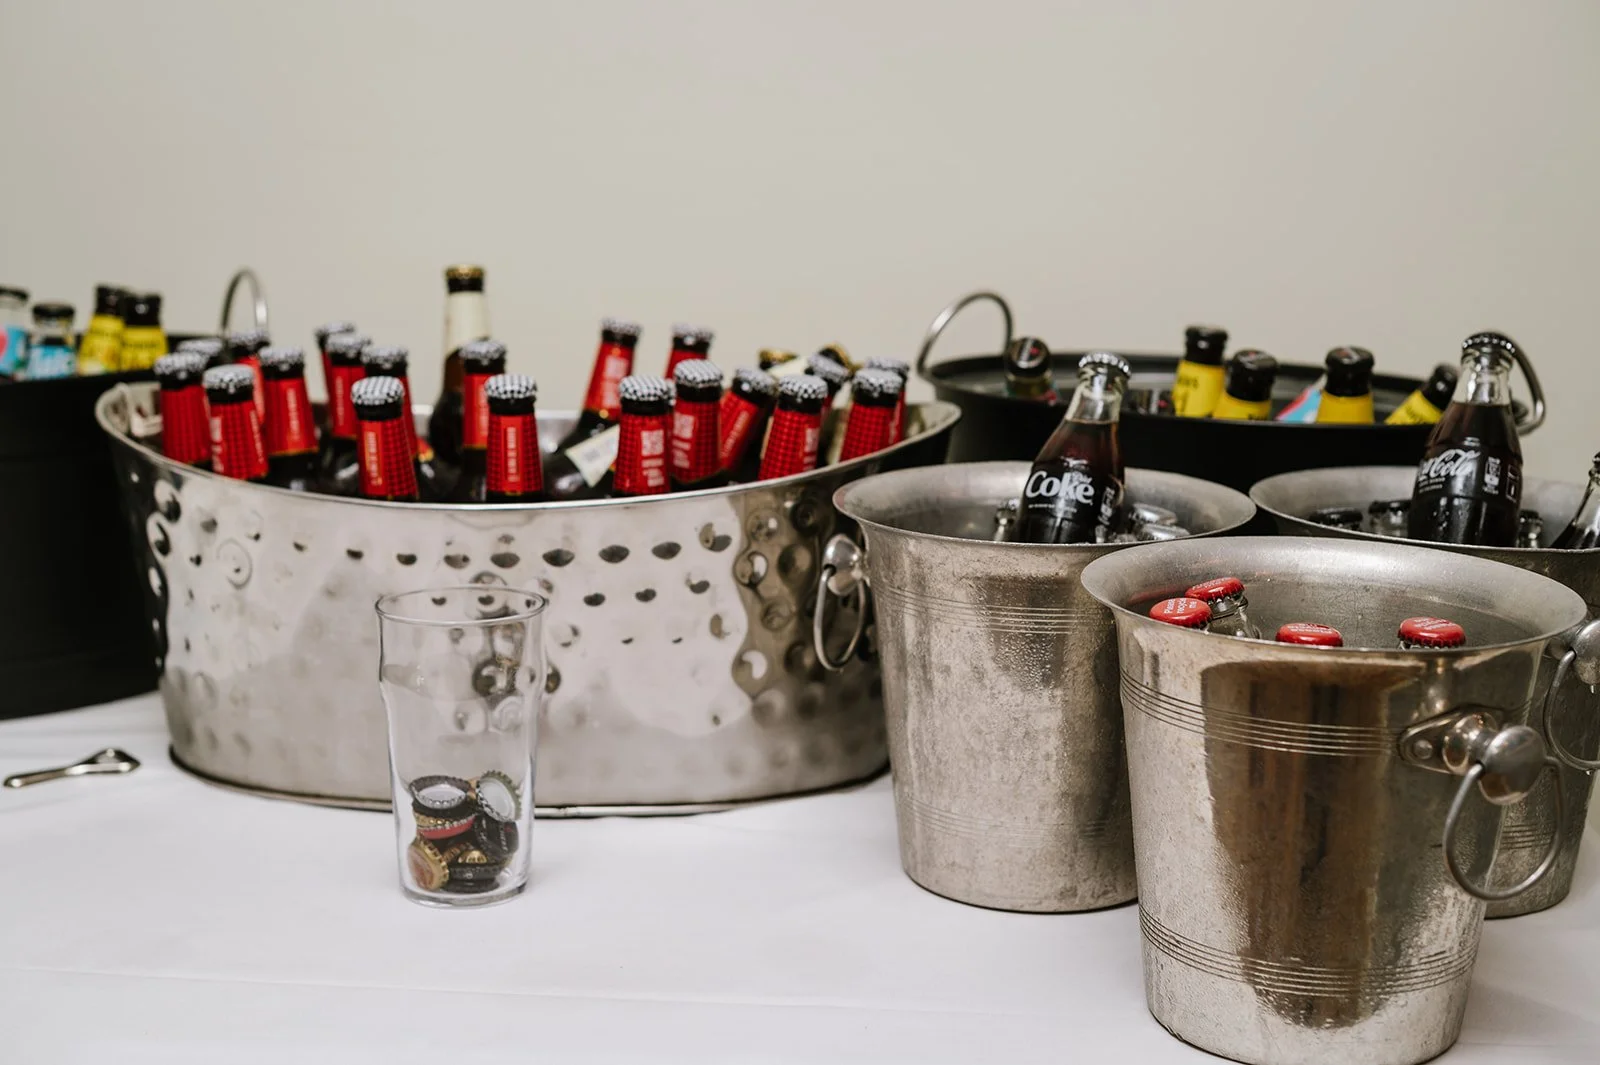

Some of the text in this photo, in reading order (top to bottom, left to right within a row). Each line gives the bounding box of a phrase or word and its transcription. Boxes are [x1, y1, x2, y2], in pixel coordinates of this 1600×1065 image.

[1025, 470, 1095, 505] Coke
[1164, 599, 1175, 613] Please
[1177, 598, 1188, 613] recycle
